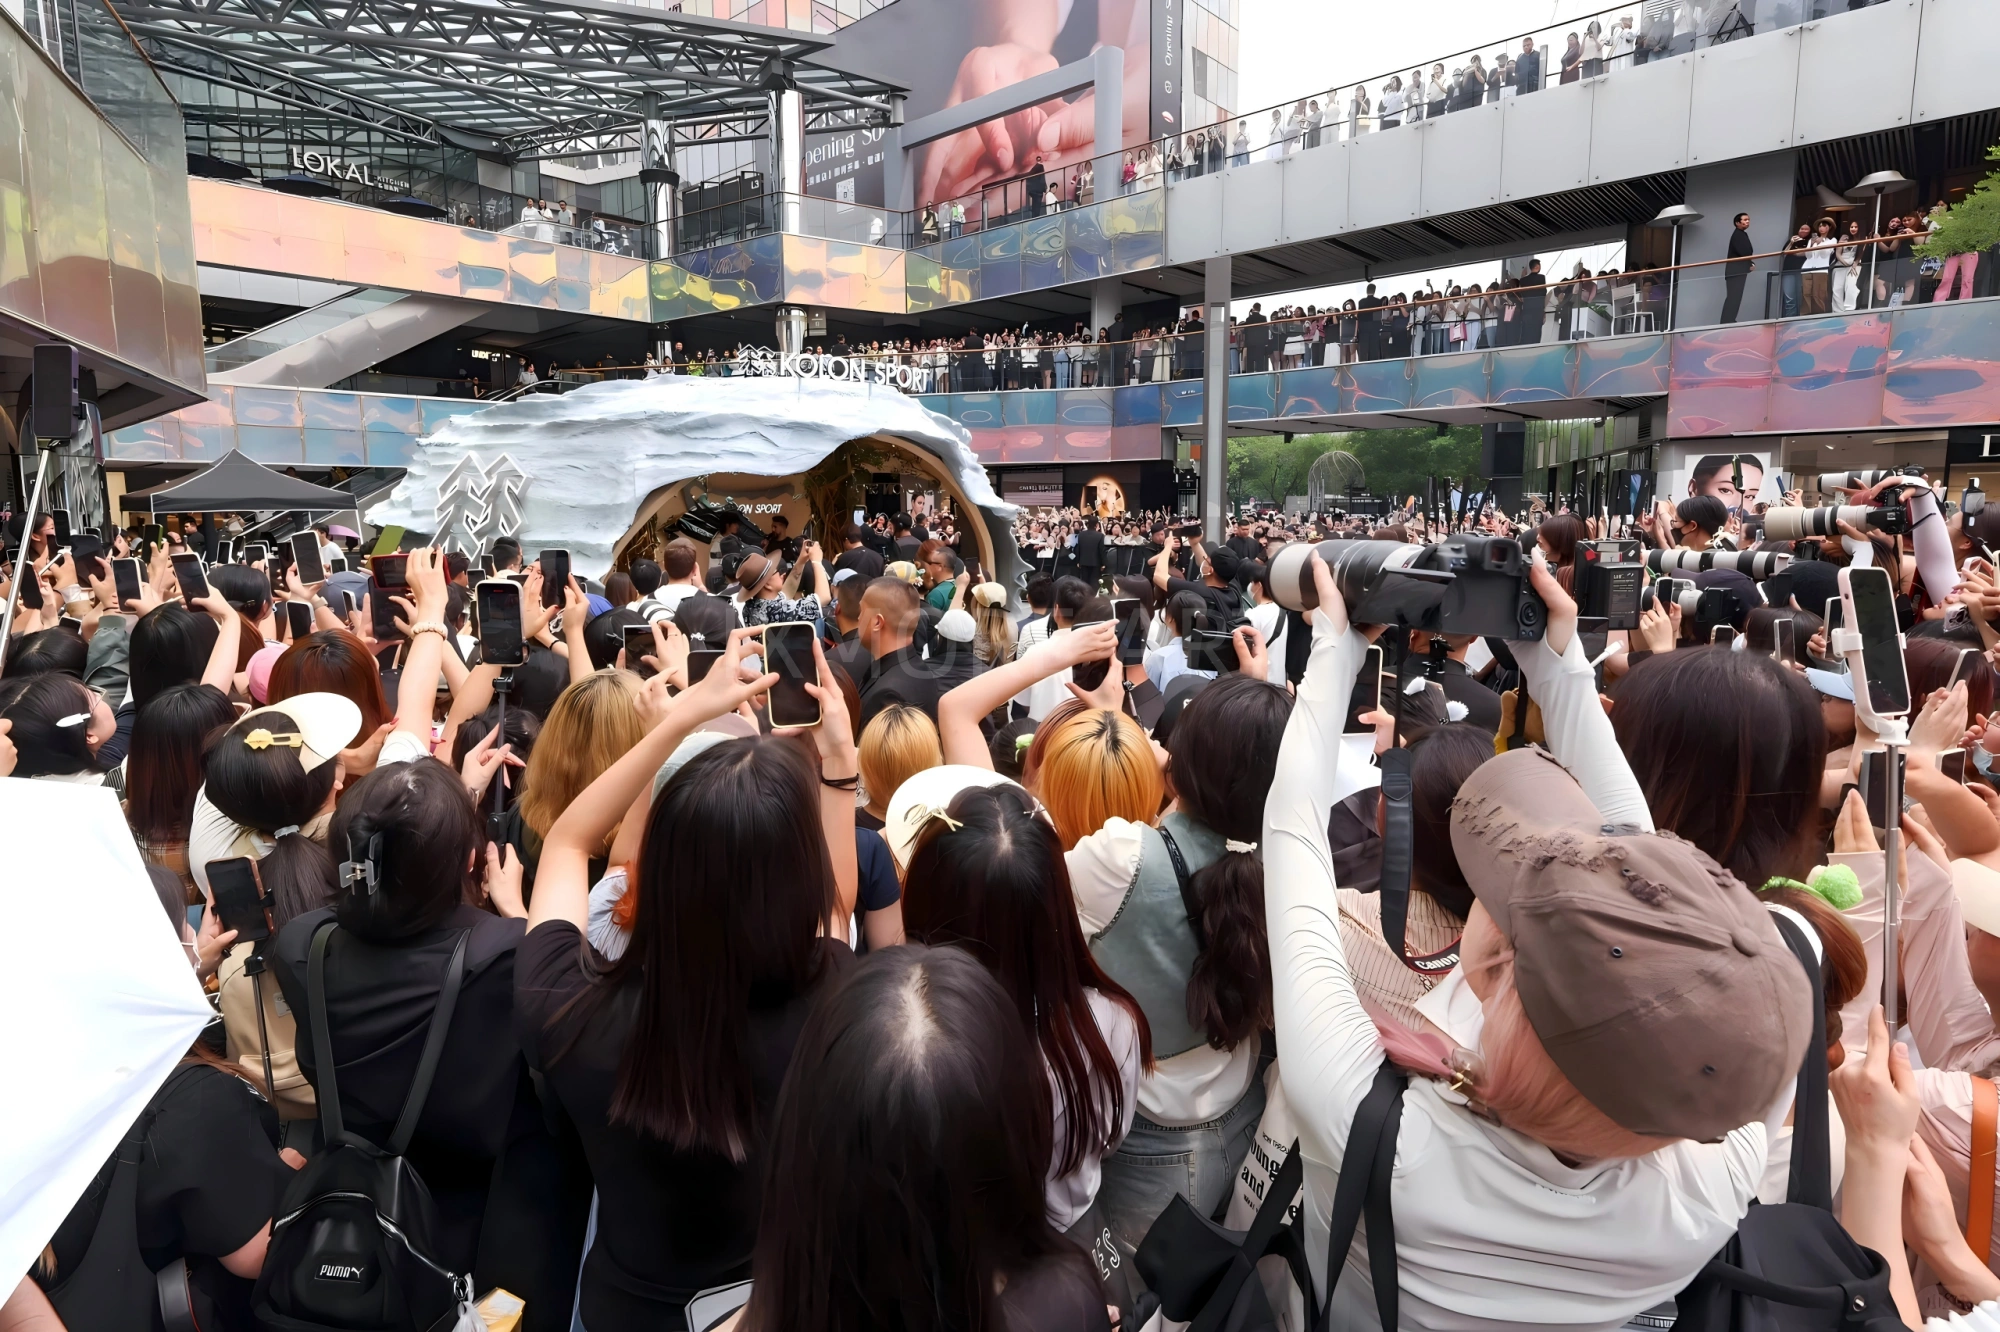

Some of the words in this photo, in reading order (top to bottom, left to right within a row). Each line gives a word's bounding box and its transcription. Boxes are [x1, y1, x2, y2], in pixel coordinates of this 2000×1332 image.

[292, 147, 375, 187] LOKAL
[805, 133, 855, 173] pening
[780, 351, 865, 383] KOLON
[874, 362, 930, 392] SPORT
[754, 503, 782, 514] SPORT
[1415, 953, 1460, 970] Canon
[1250, 1137, 1281, 1183] oung
[1241, 1165, 1265, 1201] and
[319, 1264, 351, 1278] PUMA
